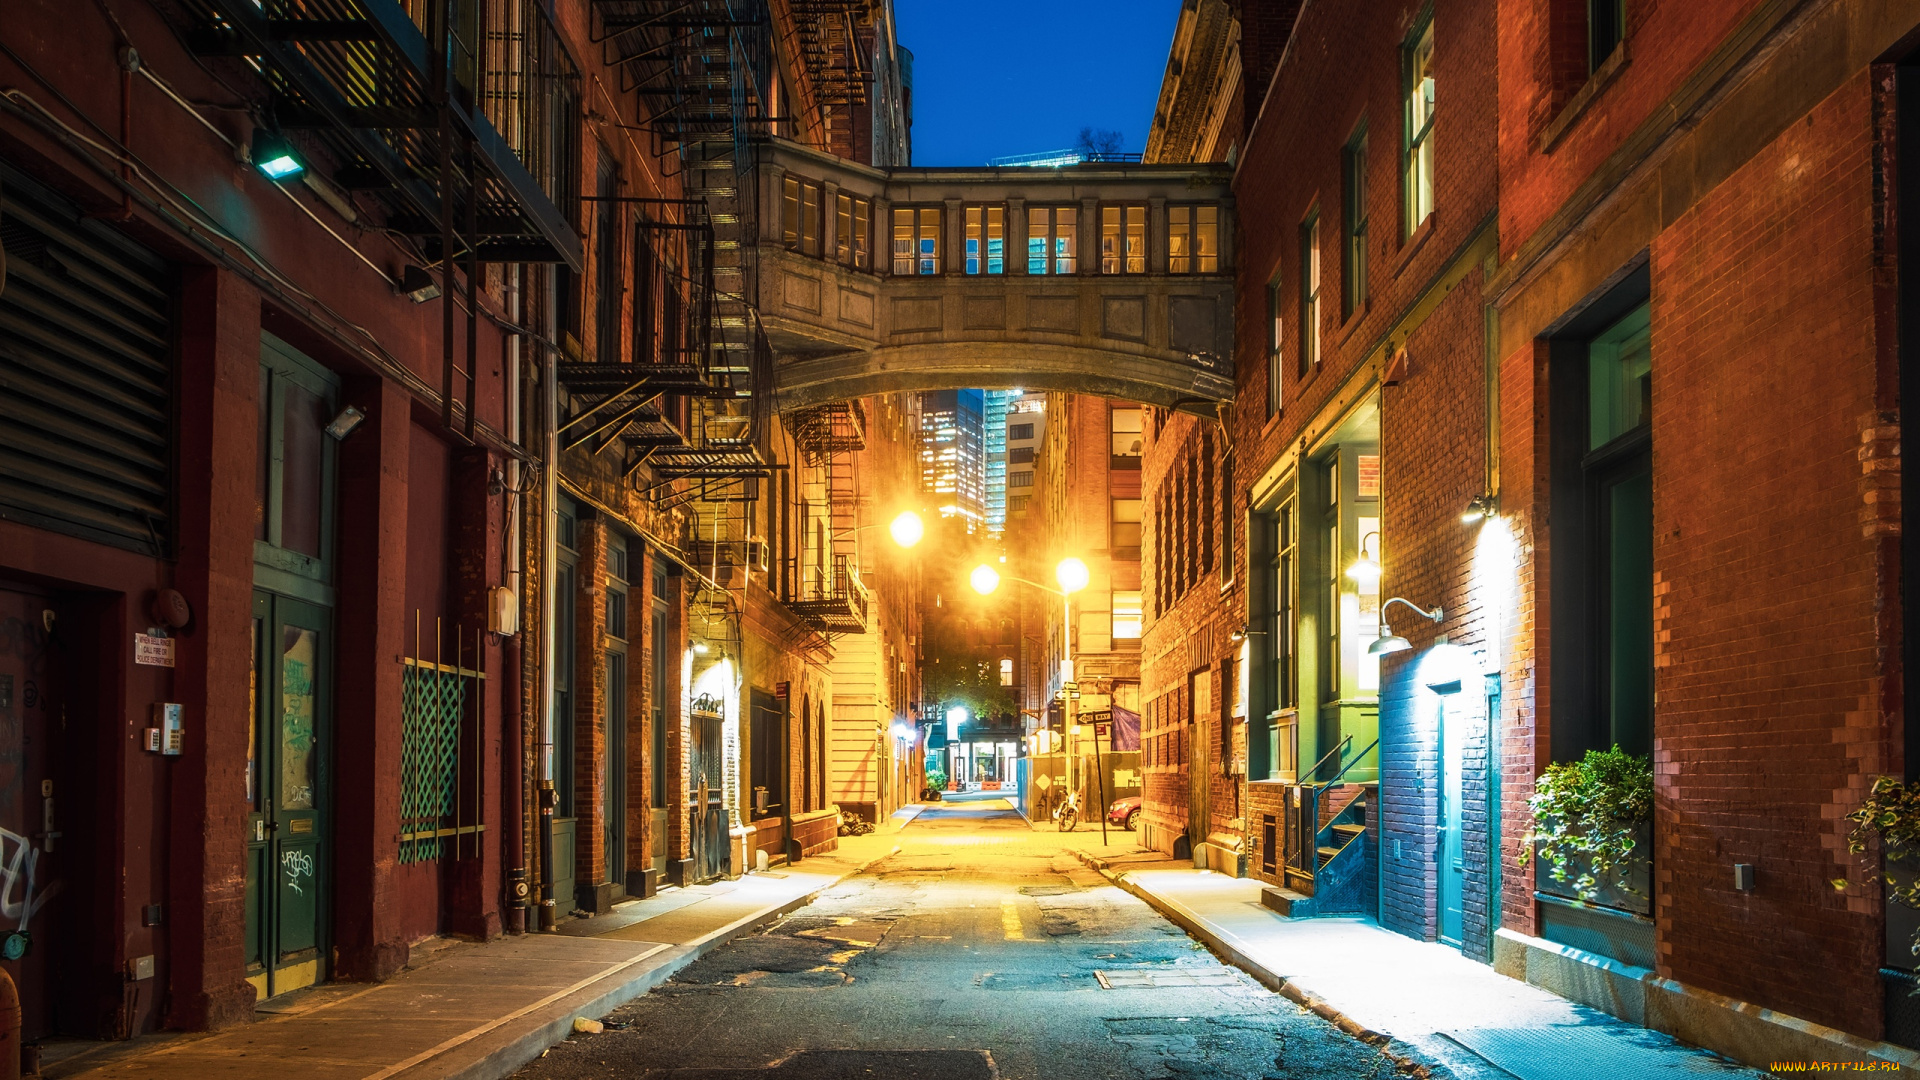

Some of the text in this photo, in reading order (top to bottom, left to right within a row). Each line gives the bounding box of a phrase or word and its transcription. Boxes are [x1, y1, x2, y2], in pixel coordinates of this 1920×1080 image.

[139, 636, 171, 647] WHEN BELL RINGS
[144, 646, 152, 654] CALL
[137, 654, 174, 666] POLICE DEPARTMENT
